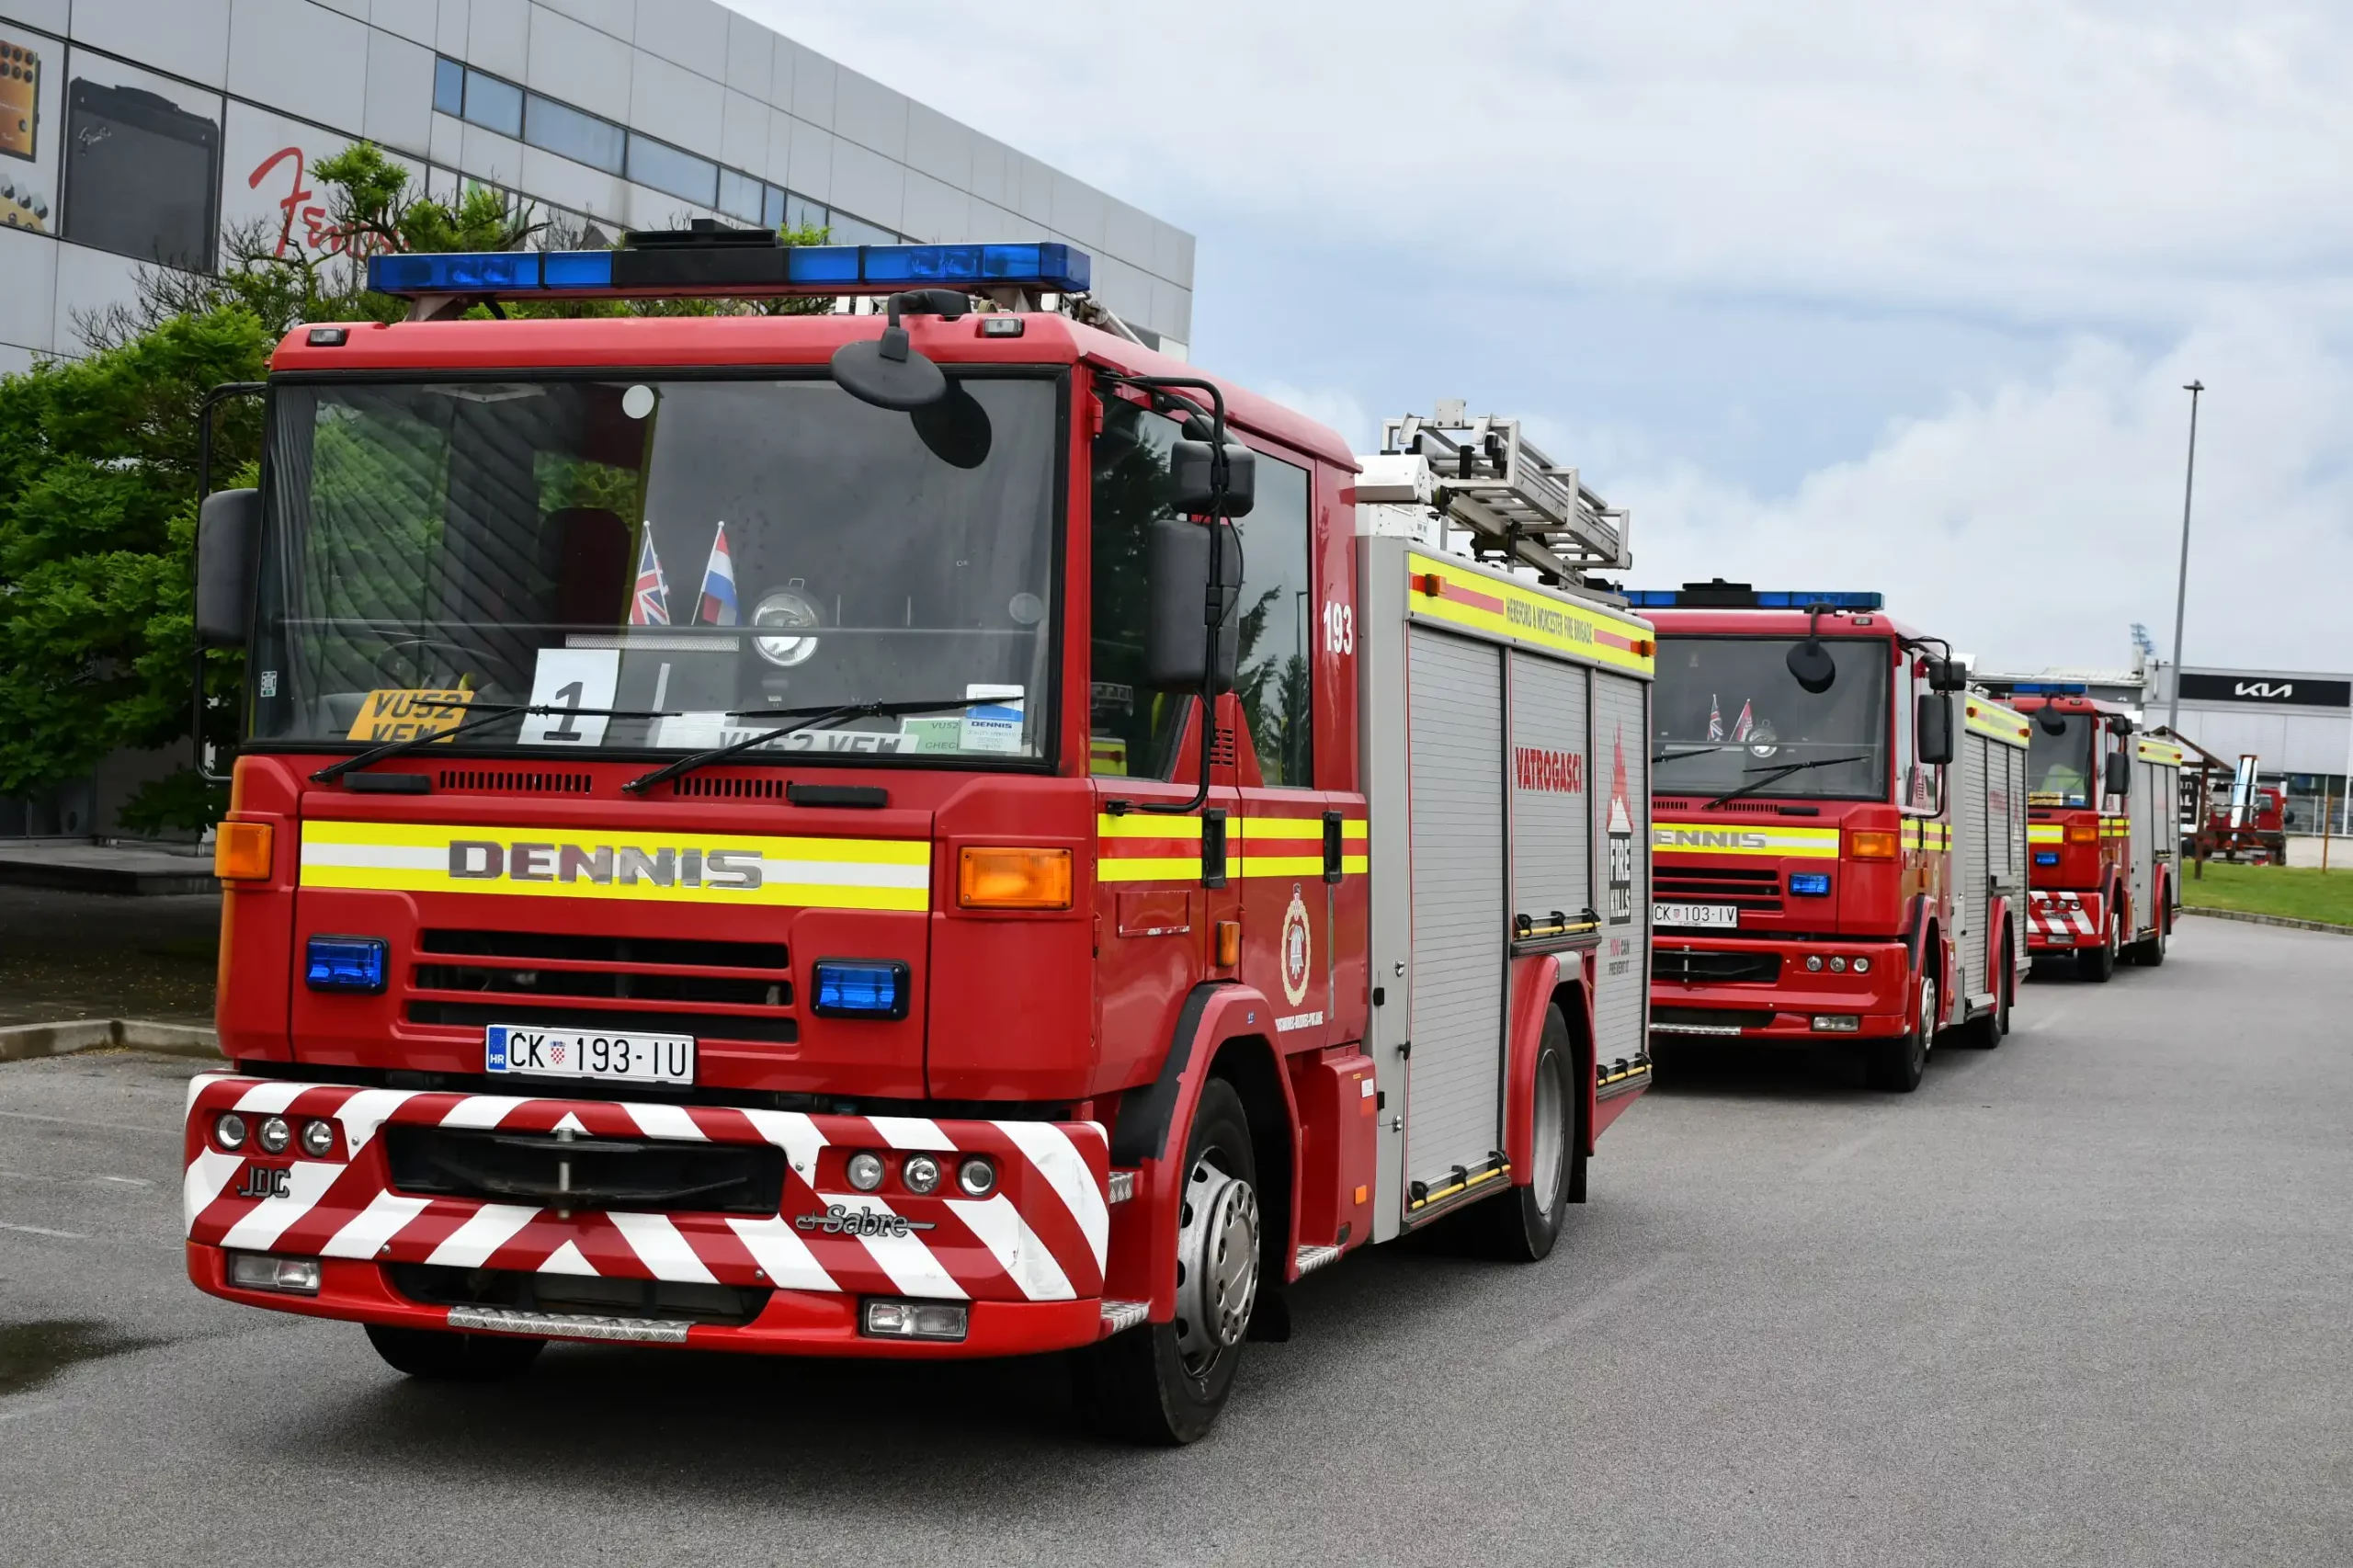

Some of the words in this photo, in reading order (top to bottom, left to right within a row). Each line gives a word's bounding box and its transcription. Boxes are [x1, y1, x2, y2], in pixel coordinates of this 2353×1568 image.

[1324, 600, 1353, 655] 193
[373, 692, 463, 720] VU52
[2234, 682, 2292, 698] KIA
[542, 681, 583, 741] 1
[972, 721, 1013, 729] DENNIS
[925, 742, 959, 750] CHEC
[1516, 746, 1582, 794] VATROGASCI
[1654, 829, 1767, 849] ENNIS
[449, 840, 763, 890] DENNIS
[1609, 838, 1631, 881] FIRE
[1609, 888, 1631, 918] KILLS
[490, 1053, 505, 1064] HR
[576, 1038, 686, 1076] 193-IU
[236, 1165, 291, 1199] JDC
[823, 1204, 908, 1238] Sabre
